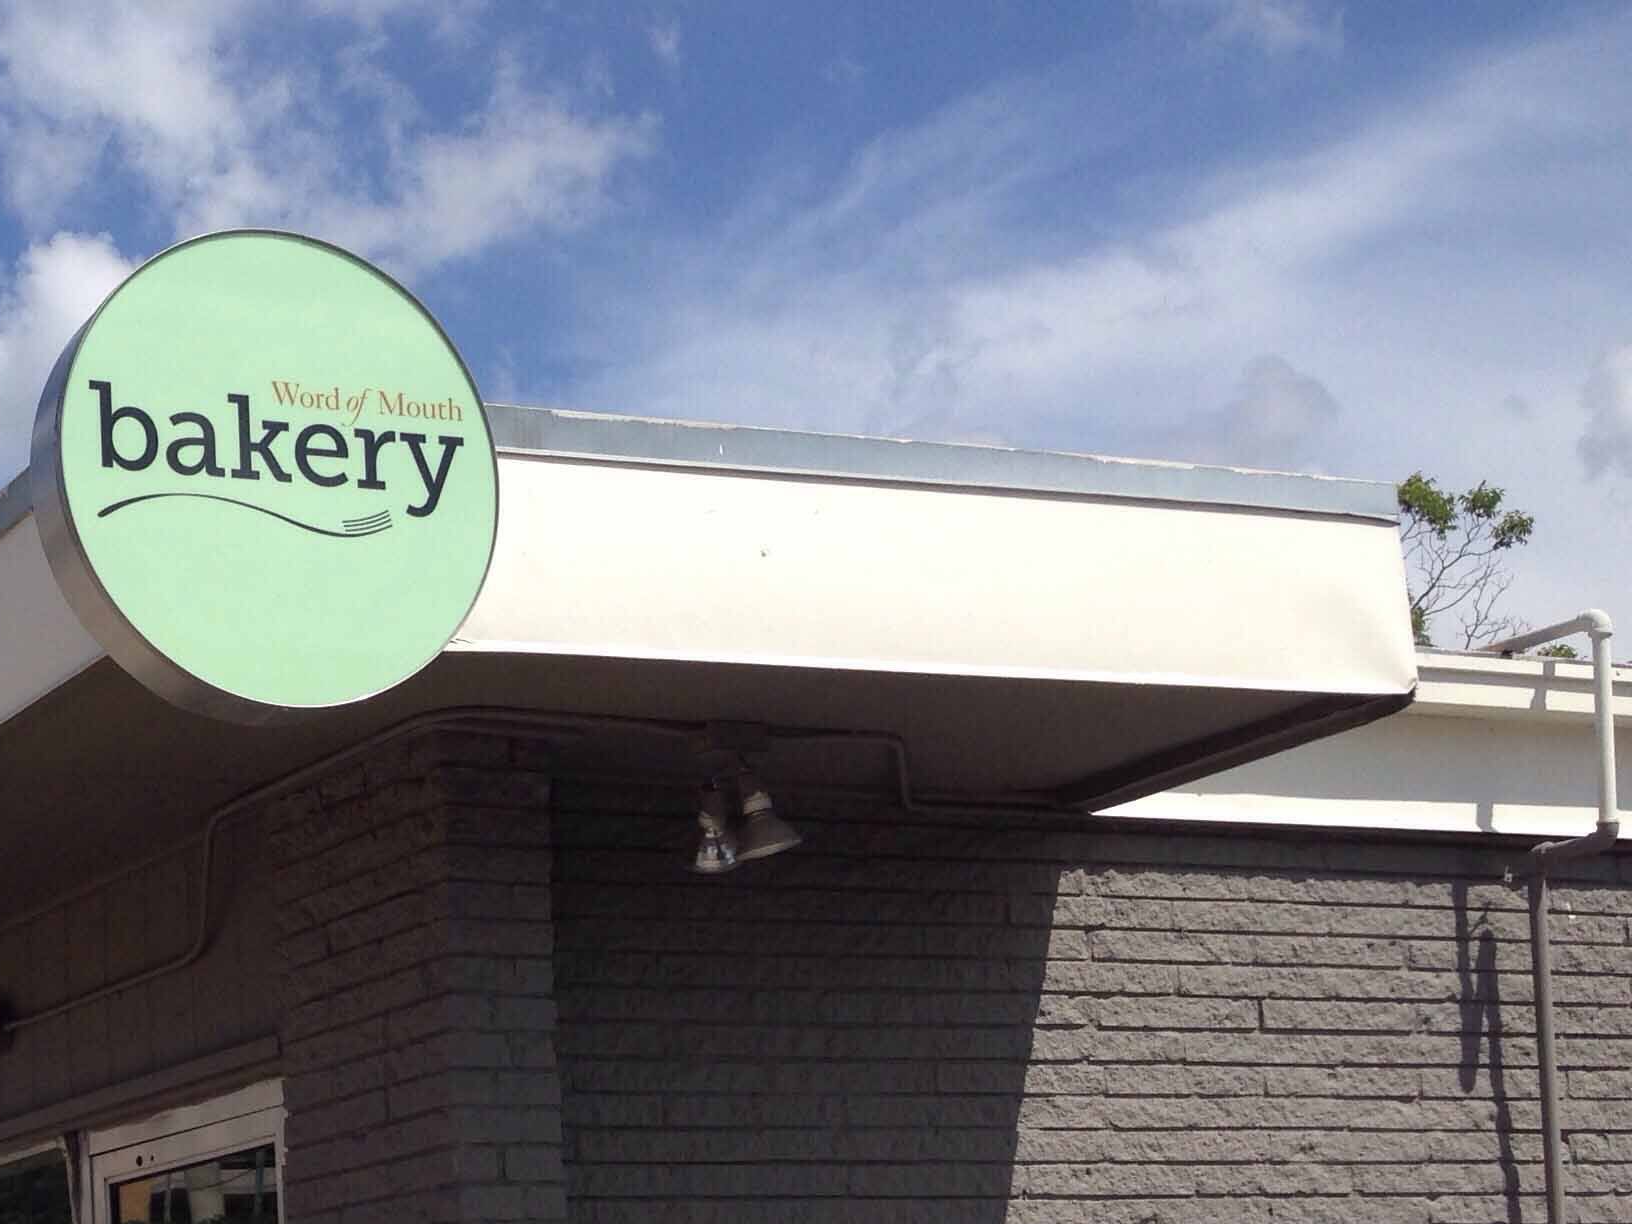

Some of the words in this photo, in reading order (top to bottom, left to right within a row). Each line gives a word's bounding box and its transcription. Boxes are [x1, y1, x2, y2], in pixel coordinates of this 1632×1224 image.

[88, 379, 465, 518] bakery
[271, 380, 340, 411] Word
[341, 387, 373, 427] of
[377, 389, 464, 422] Mouth
